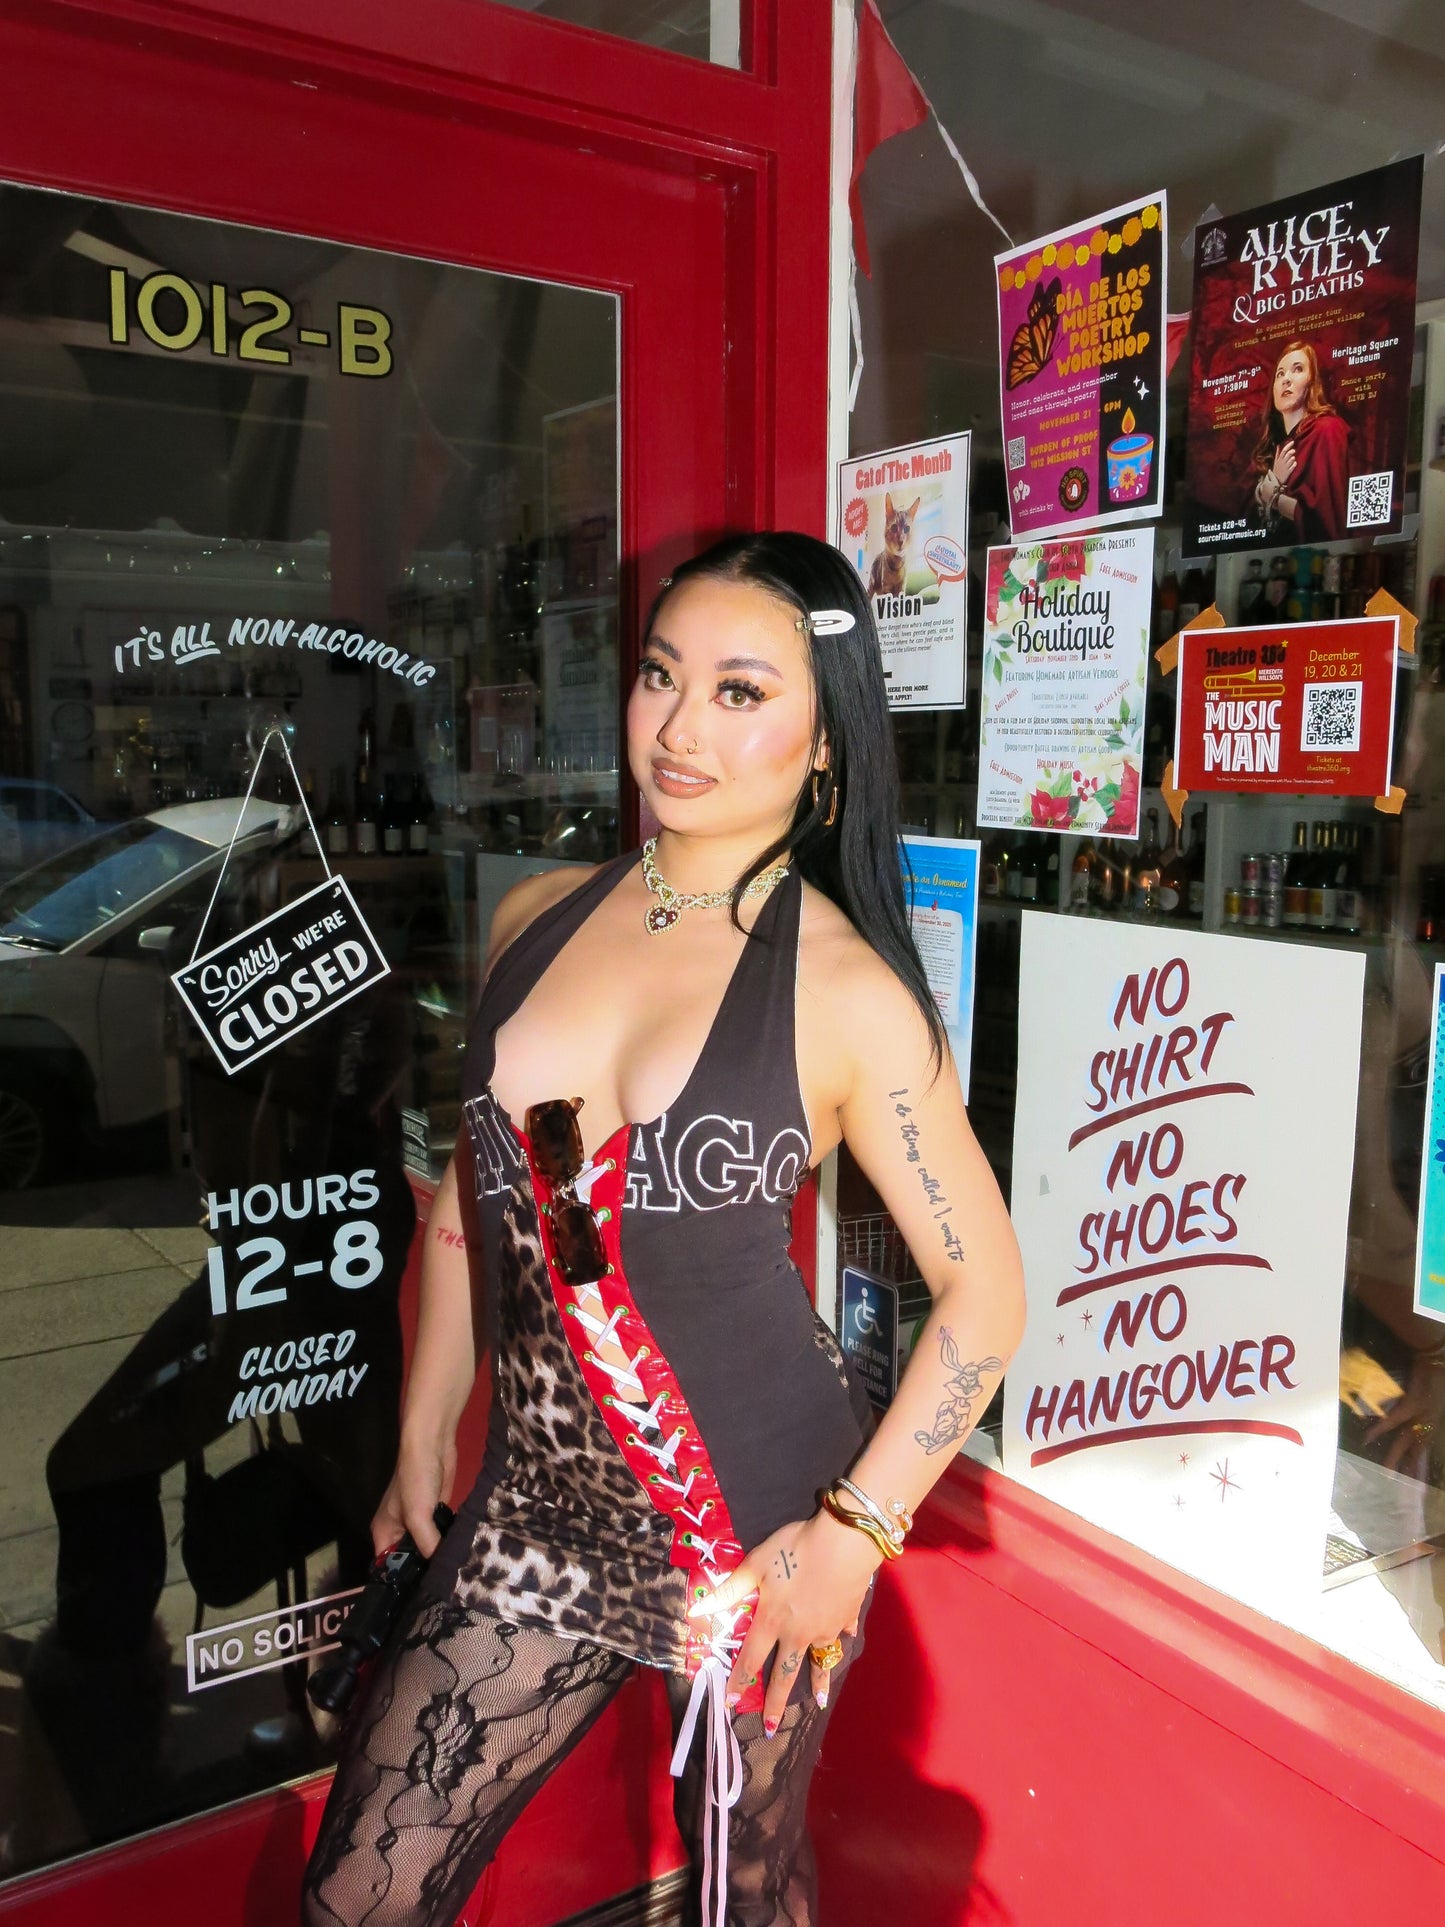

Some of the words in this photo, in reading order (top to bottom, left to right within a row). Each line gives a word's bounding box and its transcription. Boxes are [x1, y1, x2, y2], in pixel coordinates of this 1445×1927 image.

[1240, 201, 1353, 263] ALICE
[1252, 225, 1390, 295] RYLEY
[1056, 283, 1083, 315] DÍA
[1089, 276, 1110, 302] DE
[1116, 264, 1150, 293] LOS
[1232, 293, 1261, 324] &
[1255, 293, 1286, 317] BIG
[1291, 270, 1364, 306] DEATHS
[108, 267, 394, 378] 1012-B
[1062, 289, 1143, 334] MUERTOS
[1070, 312, 1135, 353] POETRY
[1056, 331, 1150, 378] WORKSHOP
[1332, 344, 1367, 358] Heritage
[1369, 337, 1399, 351] Square
[1348, 352, 1381, 365] Museum
[1082, 371, 1118, 388] remember
[1202, 374, 1236, 388] November
[1214, 387, 1221, 395] at
[1039, 412, 1080, 431] NOVEMBER
[1104, 399, 1122, 413] 6PM
[1061, 437, 1071, 449] OF
[1073, 430, 1098, 445] PROOF
[1081, 445, 1092, 456] ST
[855, 467, 874, 490] Cat
[875, 462, 886, 486] of
[887, 459, 909, 483] The
[911, 448, 952, 479] Month
[1198, 522, 1221, 533] Tickets
[877, 594, 921, 620] Vision
[1019, 584, 1110, 625] Holiday
[114, 626, 165, 673] IT'S
[170, 622, 219, 660] ALL
[227, 617, 436, 687] NON-ALCOHOLIC
[1012, 619, 1115, 661] Boutique
[1205, 645, 1257, 668] Theatre
[1309, 648, 1360, 662] December
[914, 684, 928, 692] MORE
[1304, 666, 1319, 680] 19,
[1321, 664, 1337, 678] 20
[1339, 665, 1348, 677] &
[1351, 663, 1363, 676] 21
[1204, 699, 1282, 731] MUSIC
[1206, 691, 1220, 701] THE
[1202, 732, 1281, 773] MAN
[200, 937, 286, 1010] Sorry
[291, 909, 348, 951] WE'RE
[219, 940, 369, 1052] CLOSED
[1113, 957, 1190, 1031] NO
[1083, 1012, 1237, 1113] SHIRT
[900, 1119, 920, 1163] things
[1106, 1122, 1184, 1193] NO
[207, 1168, 380, 1231] HOURS
[1073, 1173, 1248, 1274] SHOES
[207, 1220, 384, 1316] 12-8
[1103, 1284, 1188, 1354] NO
[239, 1329, 357, 1380] CLOSED
[227, 1363, 369, 1424] MONDAY
[1025, 1335, 1302, 1443] HANGOVER
[200, 1637, 244, 1675] NO
